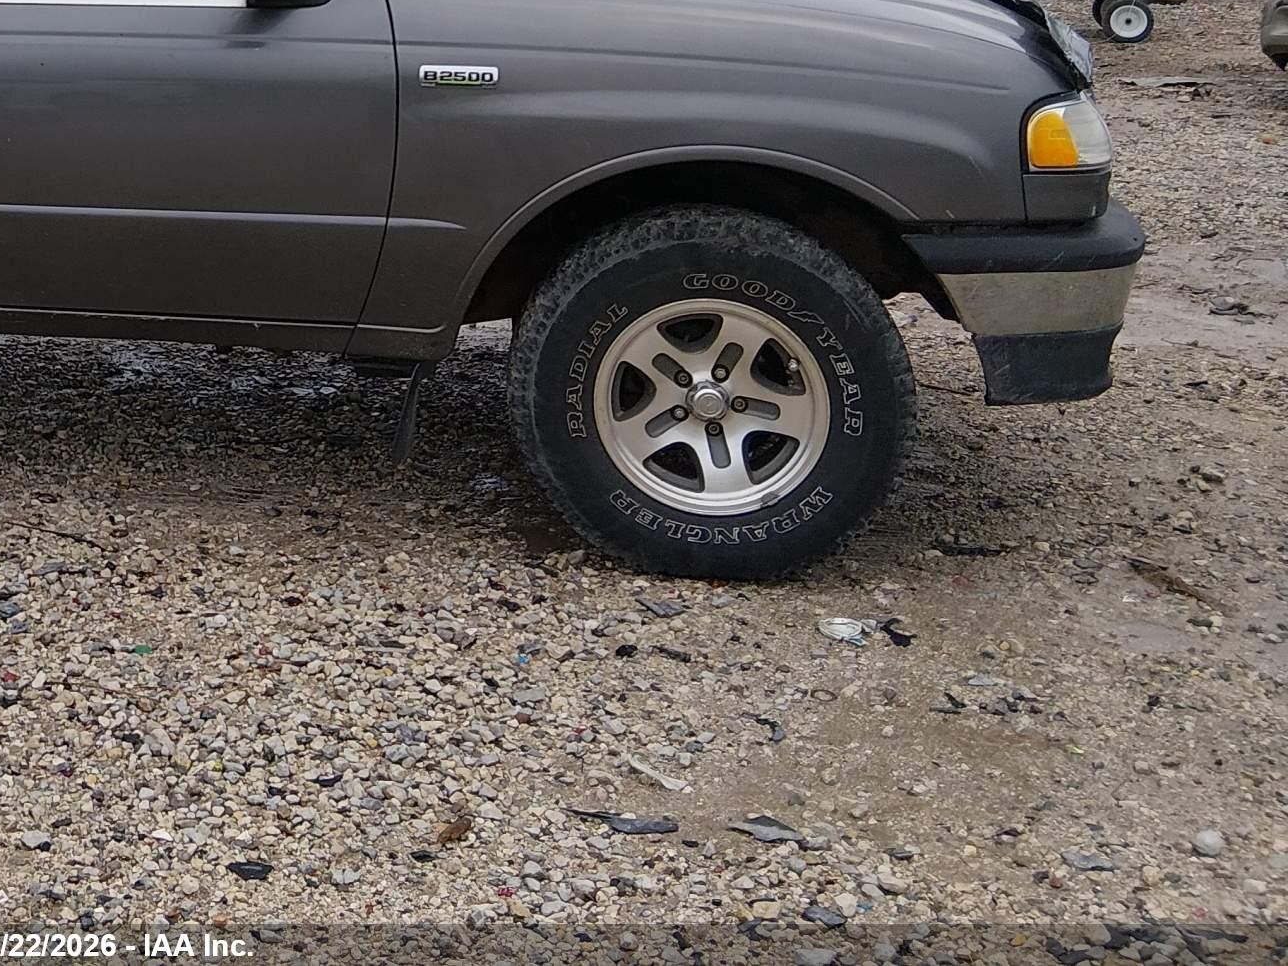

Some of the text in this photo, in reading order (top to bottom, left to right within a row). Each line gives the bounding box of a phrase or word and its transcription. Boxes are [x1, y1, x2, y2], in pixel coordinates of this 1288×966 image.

[423, 71, 494, 82] B2500
[567, 304, 628, 438] RADIAL
[610, 487, 833, 545] WRANGLER
